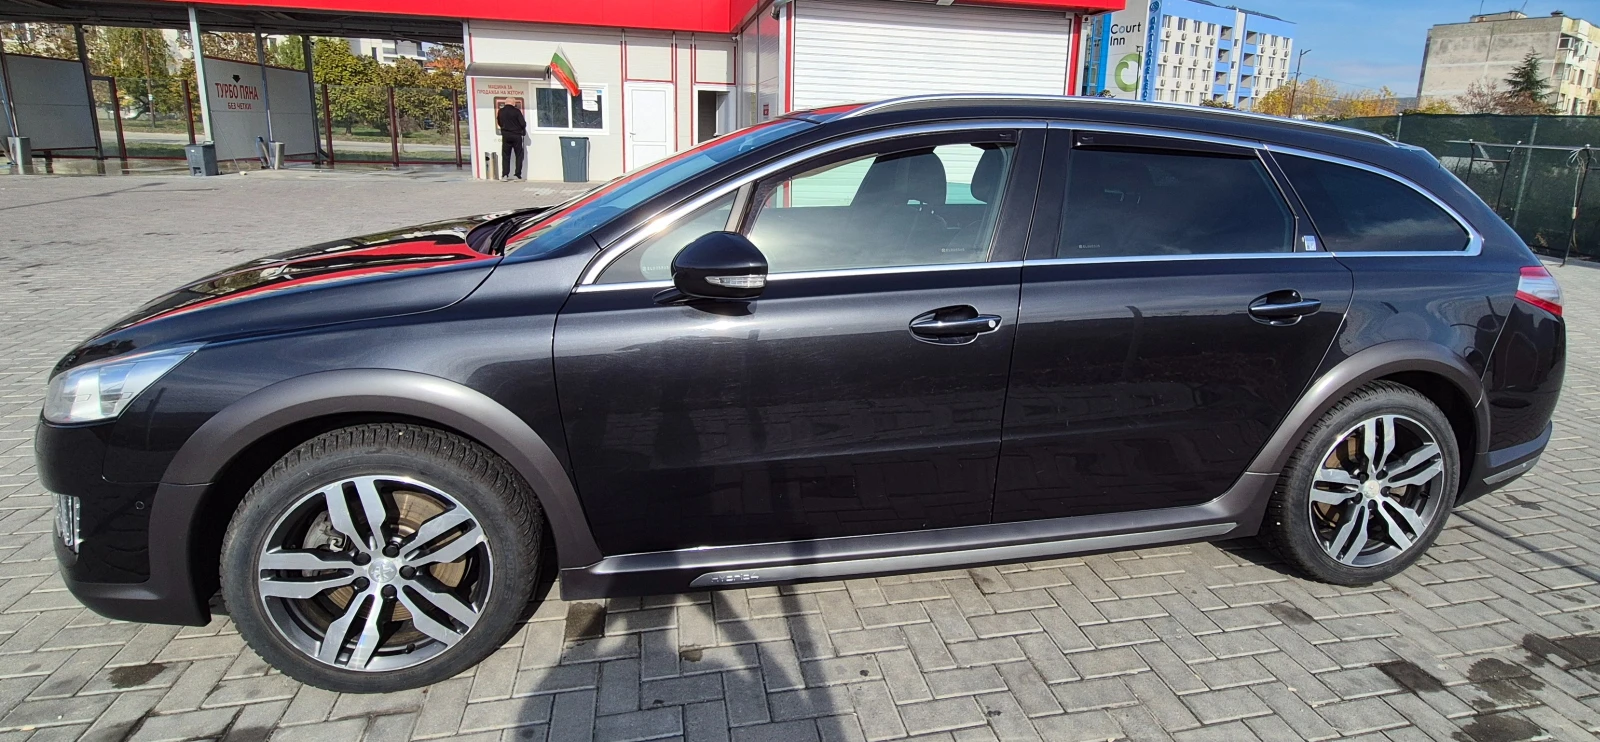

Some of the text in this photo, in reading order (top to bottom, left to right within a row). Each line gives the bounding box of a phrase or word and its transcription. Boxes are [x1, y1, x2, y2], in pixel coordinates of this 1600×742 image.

[1110, 22, 1142, 35] Court
[1109, 36, 1126, 46] Inn
[215, 82, 259, 100] ТУРБО ПЯНА
[227, 102, 252, 110] БЕЗ ЧЕТКИ
